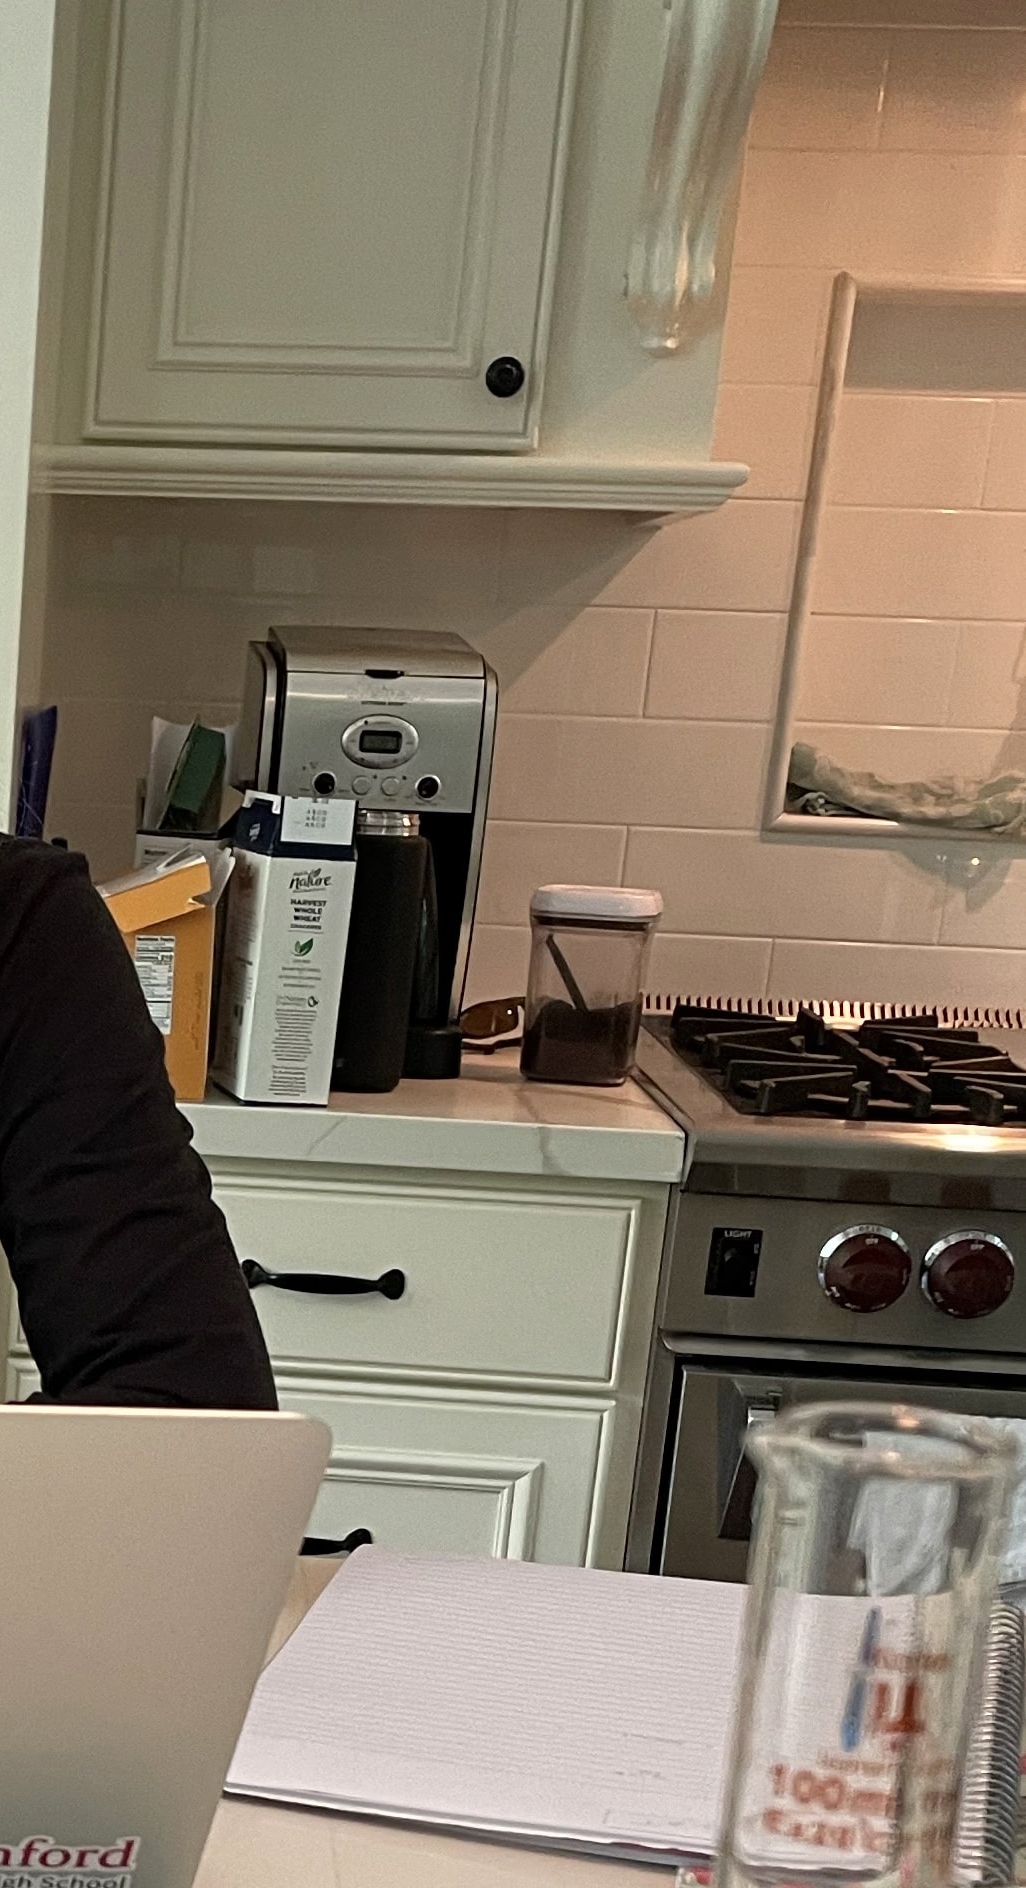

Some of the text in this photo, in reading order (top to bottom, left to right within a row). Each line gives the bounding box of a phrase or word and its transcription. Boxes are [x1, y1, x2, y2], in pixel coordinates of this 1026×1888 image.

[290, 899, 327, 907] HARVEST
[724, 1230, 752, 1238] LIGHT
[40, 1875, 127, 1888] School
